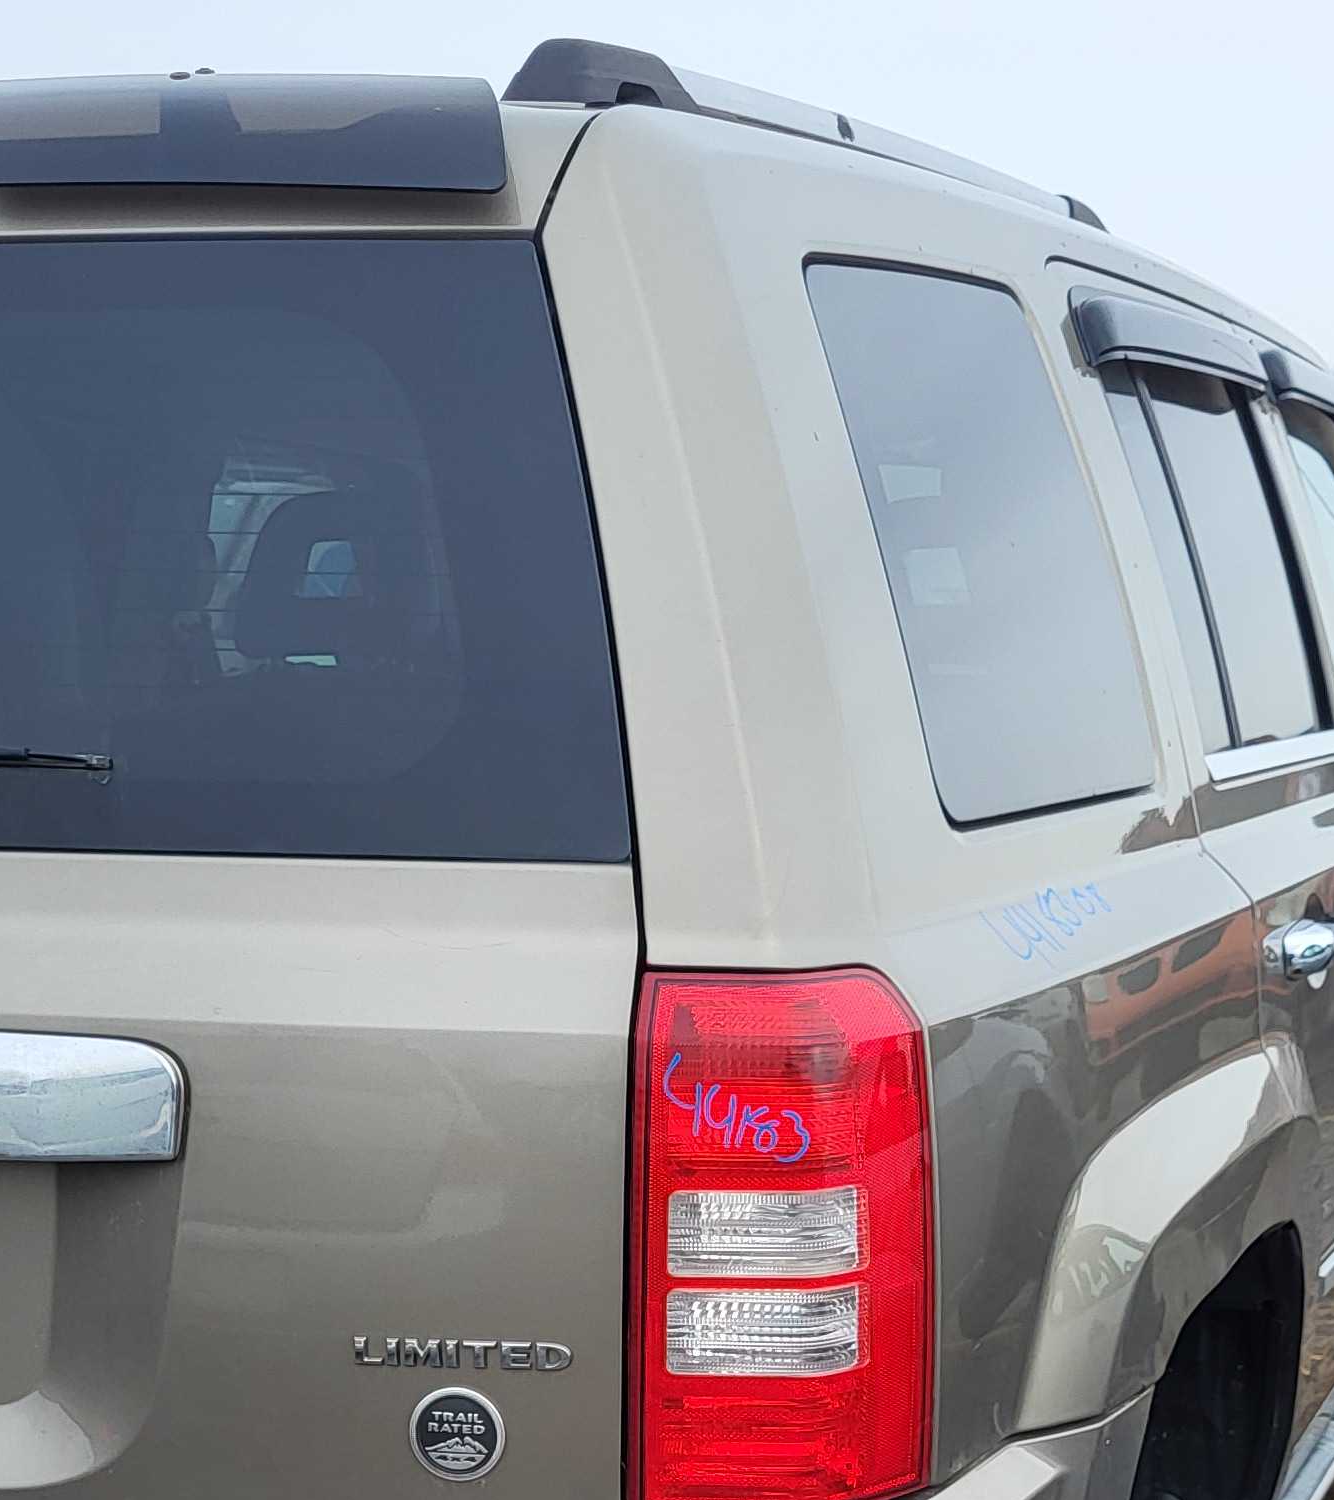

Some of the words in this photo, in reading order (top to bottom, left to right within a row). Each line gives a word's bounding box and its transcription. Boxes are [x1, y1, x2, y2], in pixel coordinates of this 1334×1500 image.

[663, 1051, 811, 1163] 44183
[352, 1335, 573, 1371] LIMITED
[427, 1421, 486, 1436] RATED
[431, 1410, 484, 1424] TRAIL
